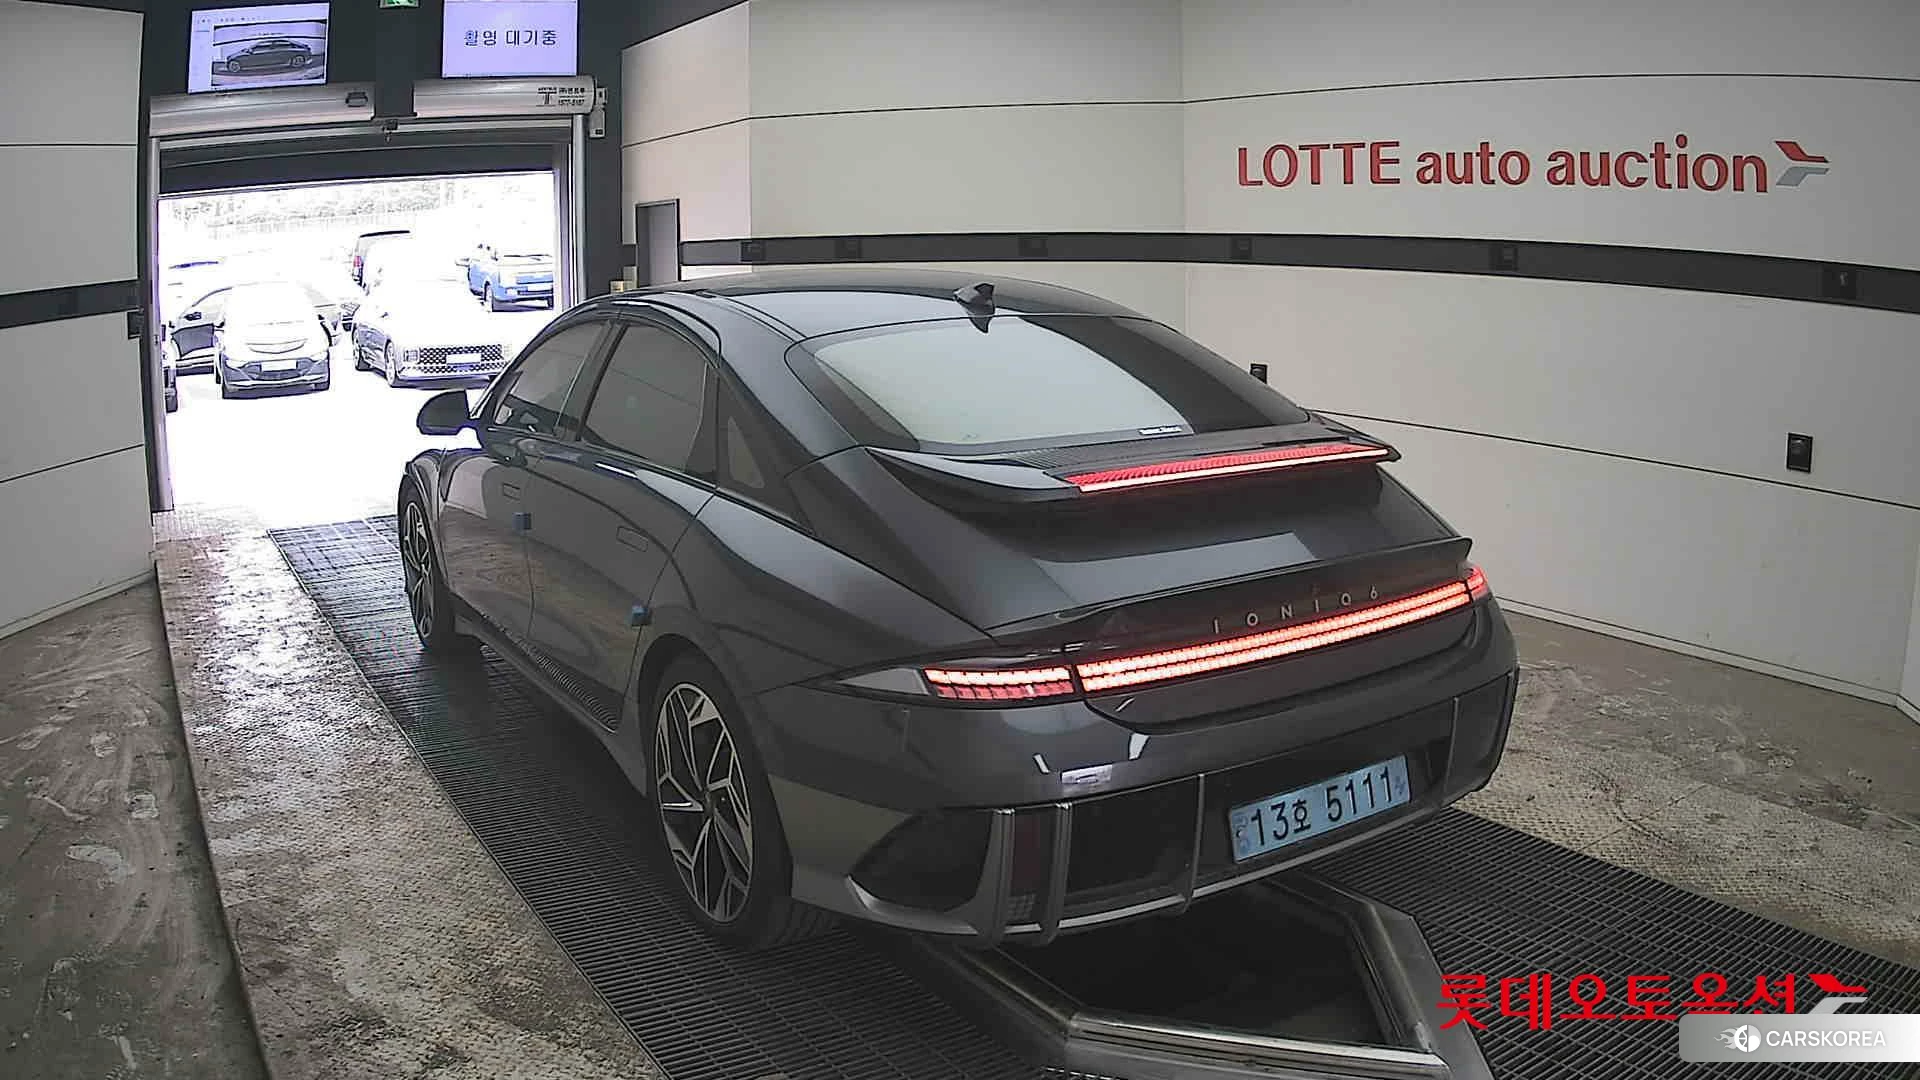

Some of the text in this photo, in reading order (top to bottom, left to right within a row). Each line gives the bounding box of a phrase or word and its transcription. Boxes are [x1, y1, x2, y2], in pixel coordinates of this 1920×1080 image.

[506, 29, 557, 46] 대기중
[1238, 134, 1768, 193] LOTTE auto auction
[1251, 766, 1392, 846] 13호 5111
